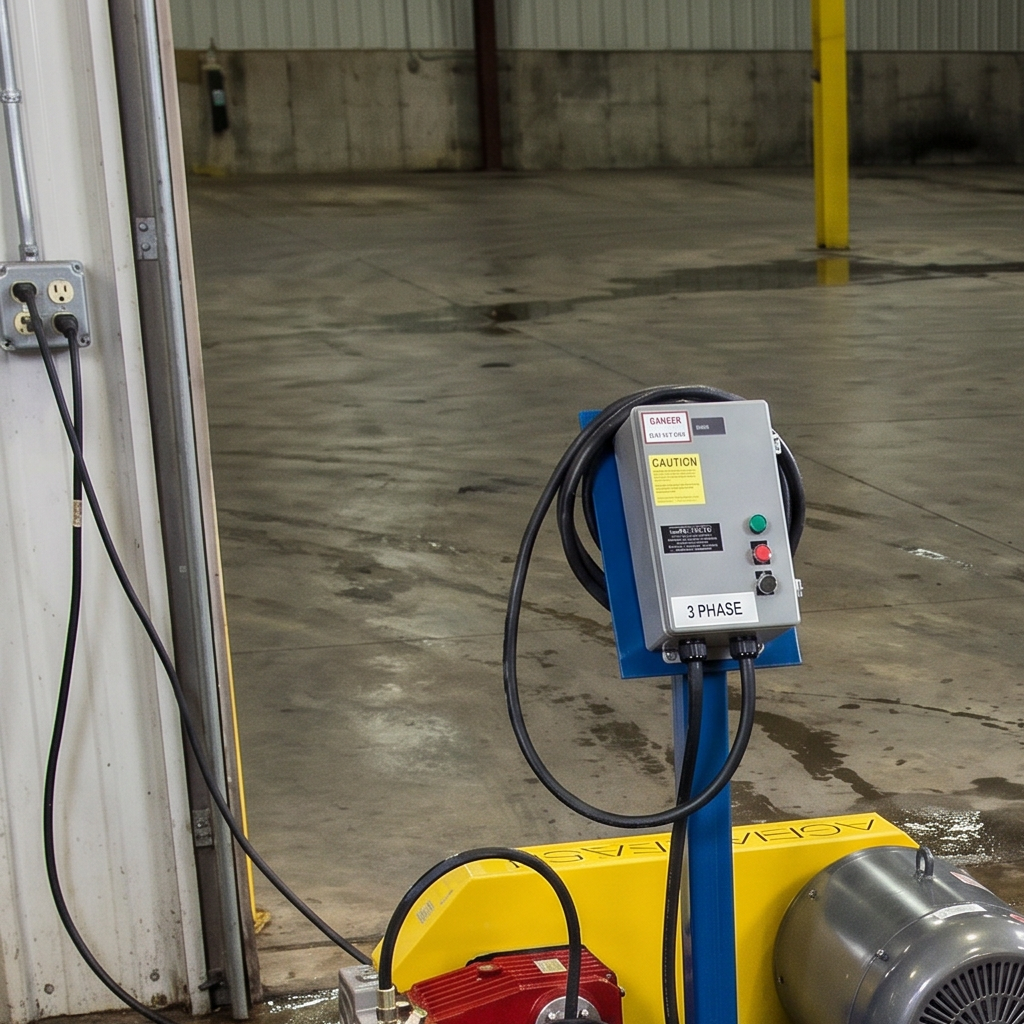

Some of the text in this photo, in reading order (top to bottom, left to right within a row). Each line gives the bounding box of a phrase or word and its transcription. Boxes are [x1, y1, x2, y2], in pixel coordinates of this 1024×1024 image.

[652, 457, 698, 468] CAUTION
[687, 601, 743, 619] 3 PHASE
